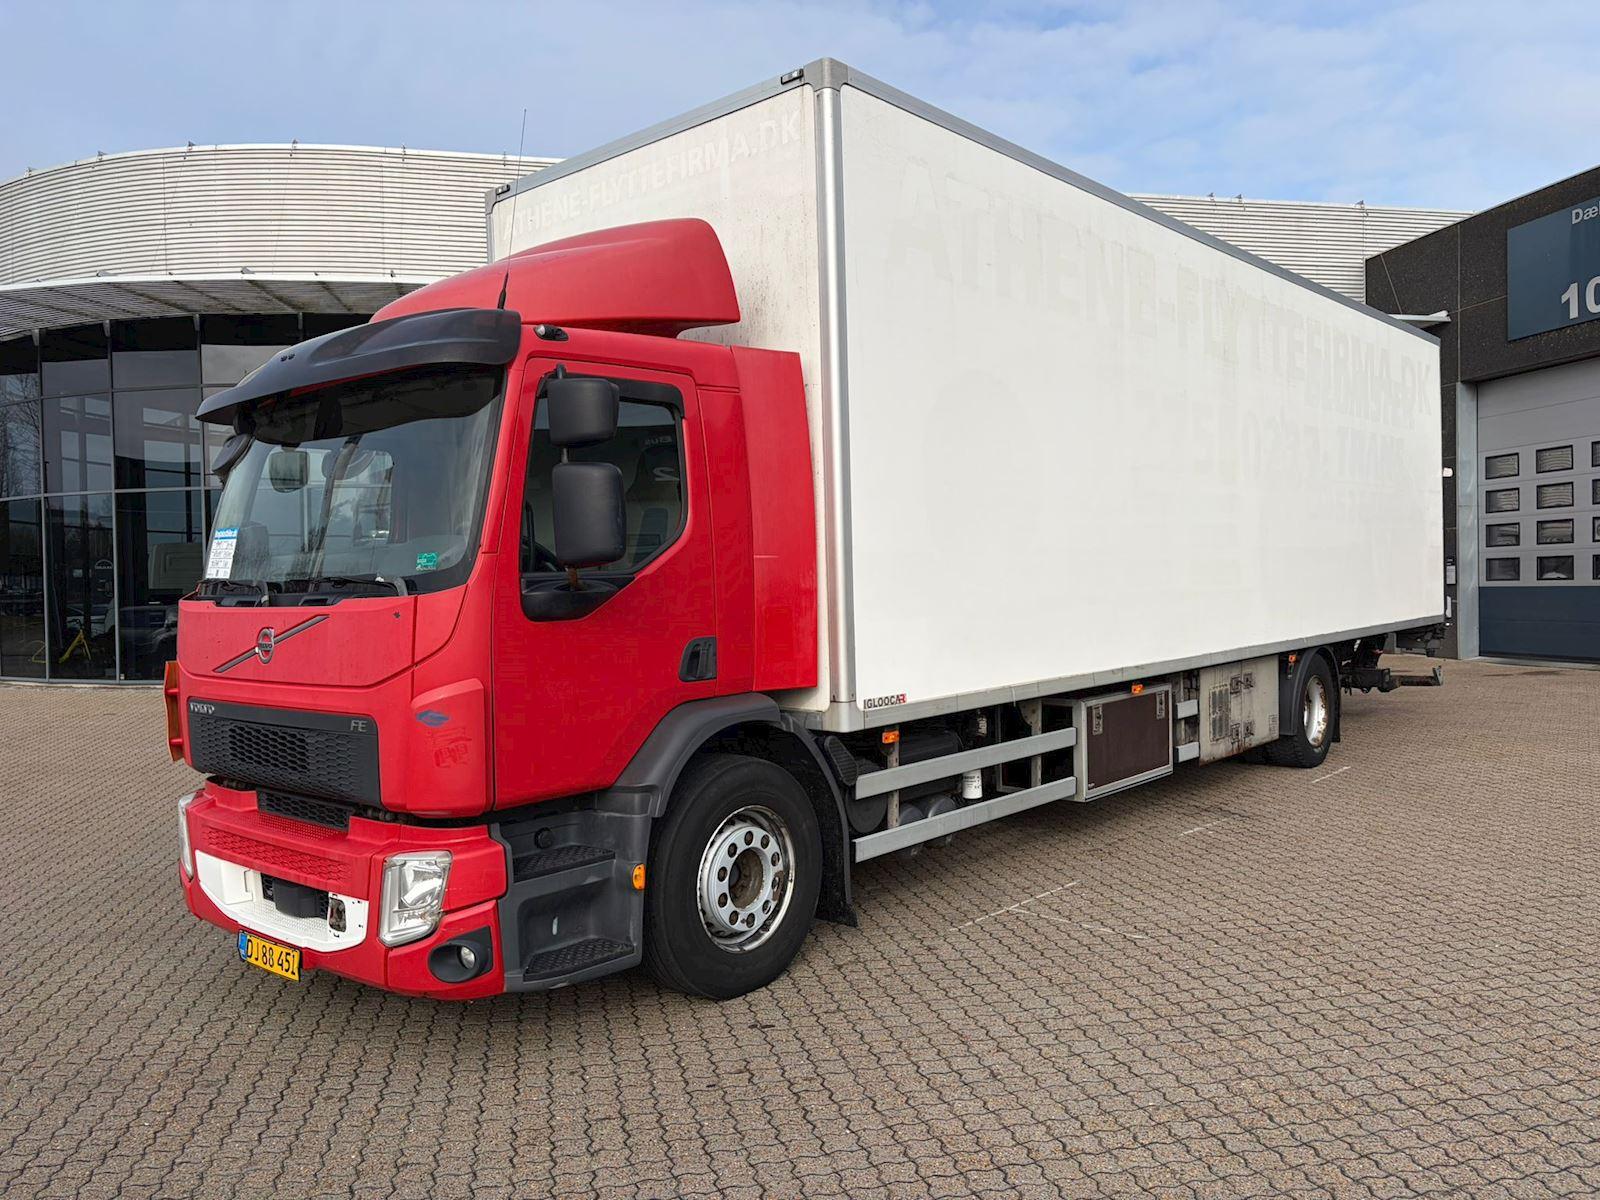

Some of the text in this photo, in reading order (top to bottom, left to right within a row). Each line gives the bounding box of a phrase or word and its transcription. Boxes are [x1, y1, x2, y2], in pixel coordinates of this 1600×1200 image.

[1571, 200, 1600, 225] Dæ
[863, 693, 906, 710] IGLOOCAR
[246, 938, 296, 976] DJ 88 451
